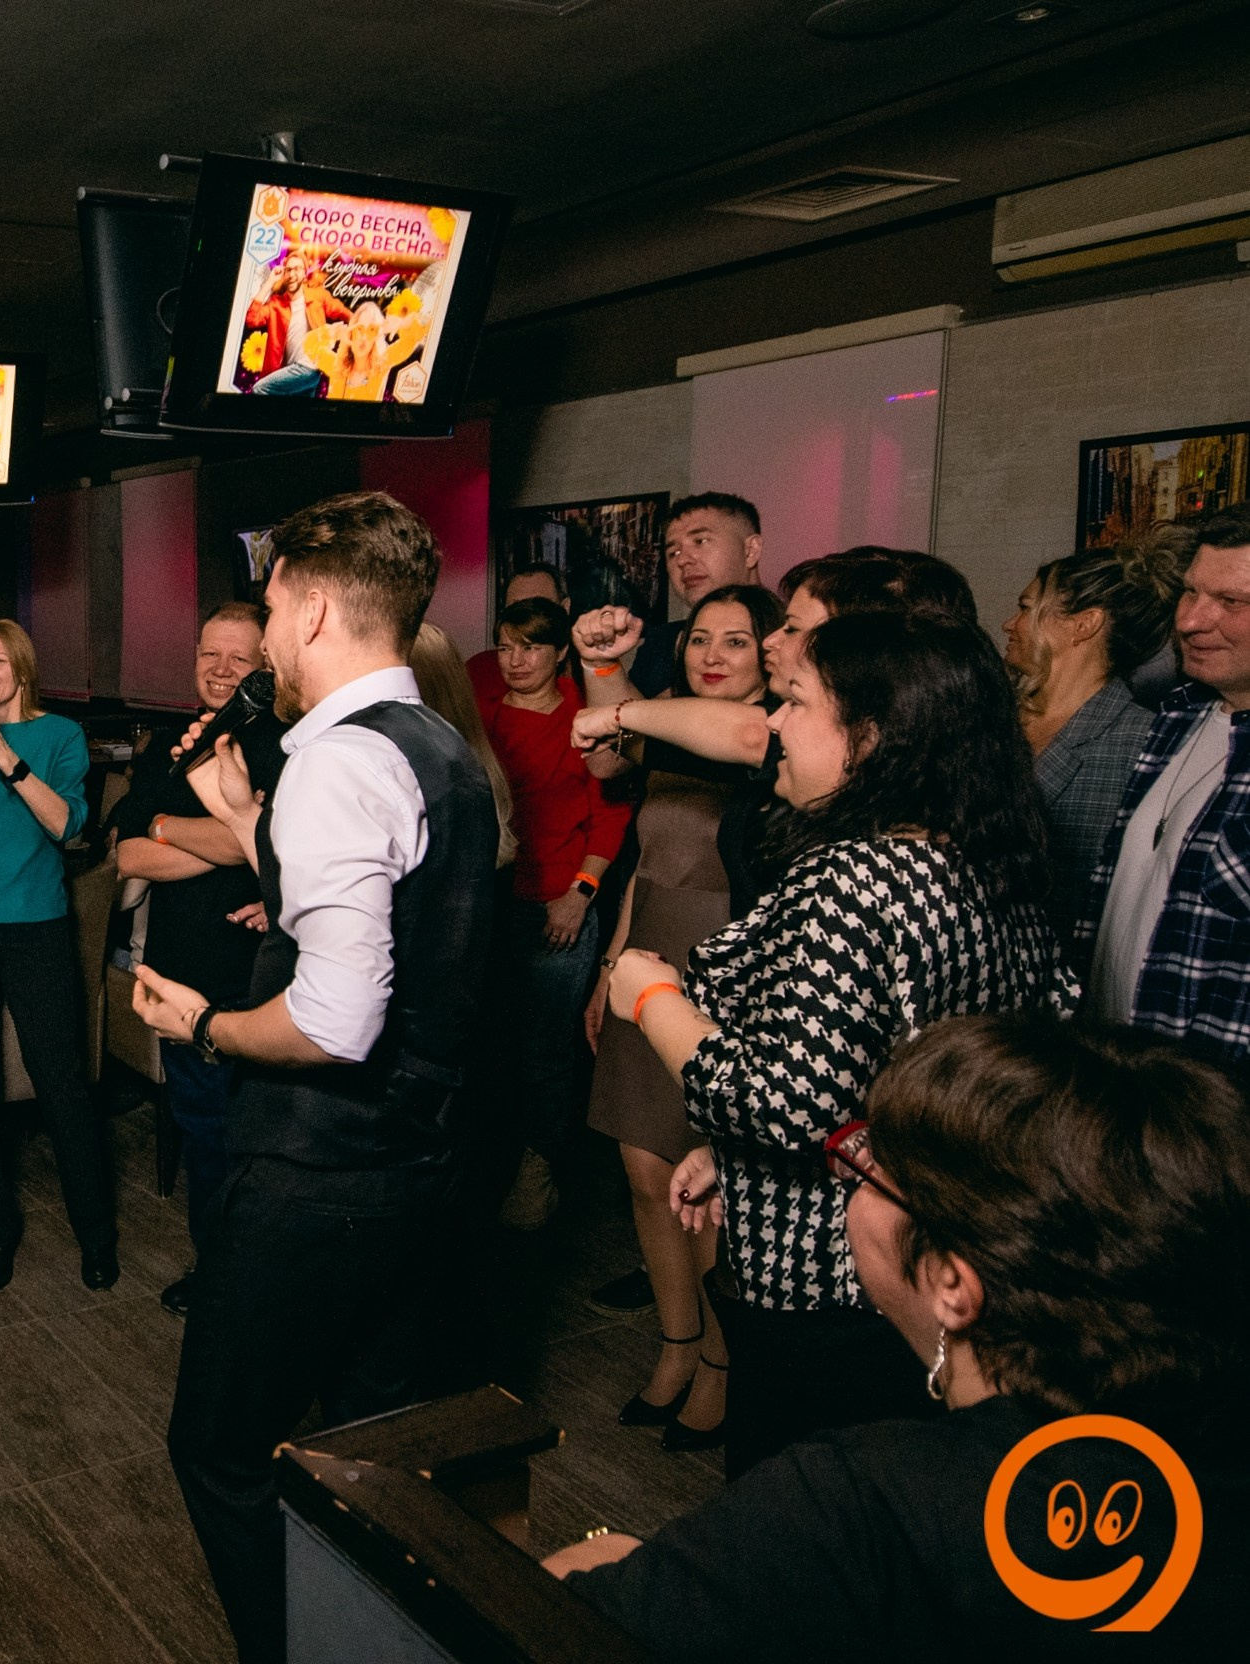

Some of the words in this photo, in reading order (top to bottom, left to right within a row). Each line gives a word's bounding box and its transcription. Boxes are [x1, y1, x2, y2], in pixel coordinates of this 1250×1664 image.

[254, 228, 277, 245] 22
[288, 205, 354, 226] СКОРО
[361, 214, 426, 238] ВЕСНА,
[300, 227, 365, 248] СКОРО
[372, 236, 445, 257] ВЕСНА...
[321, 249, 379, 287] клубная
